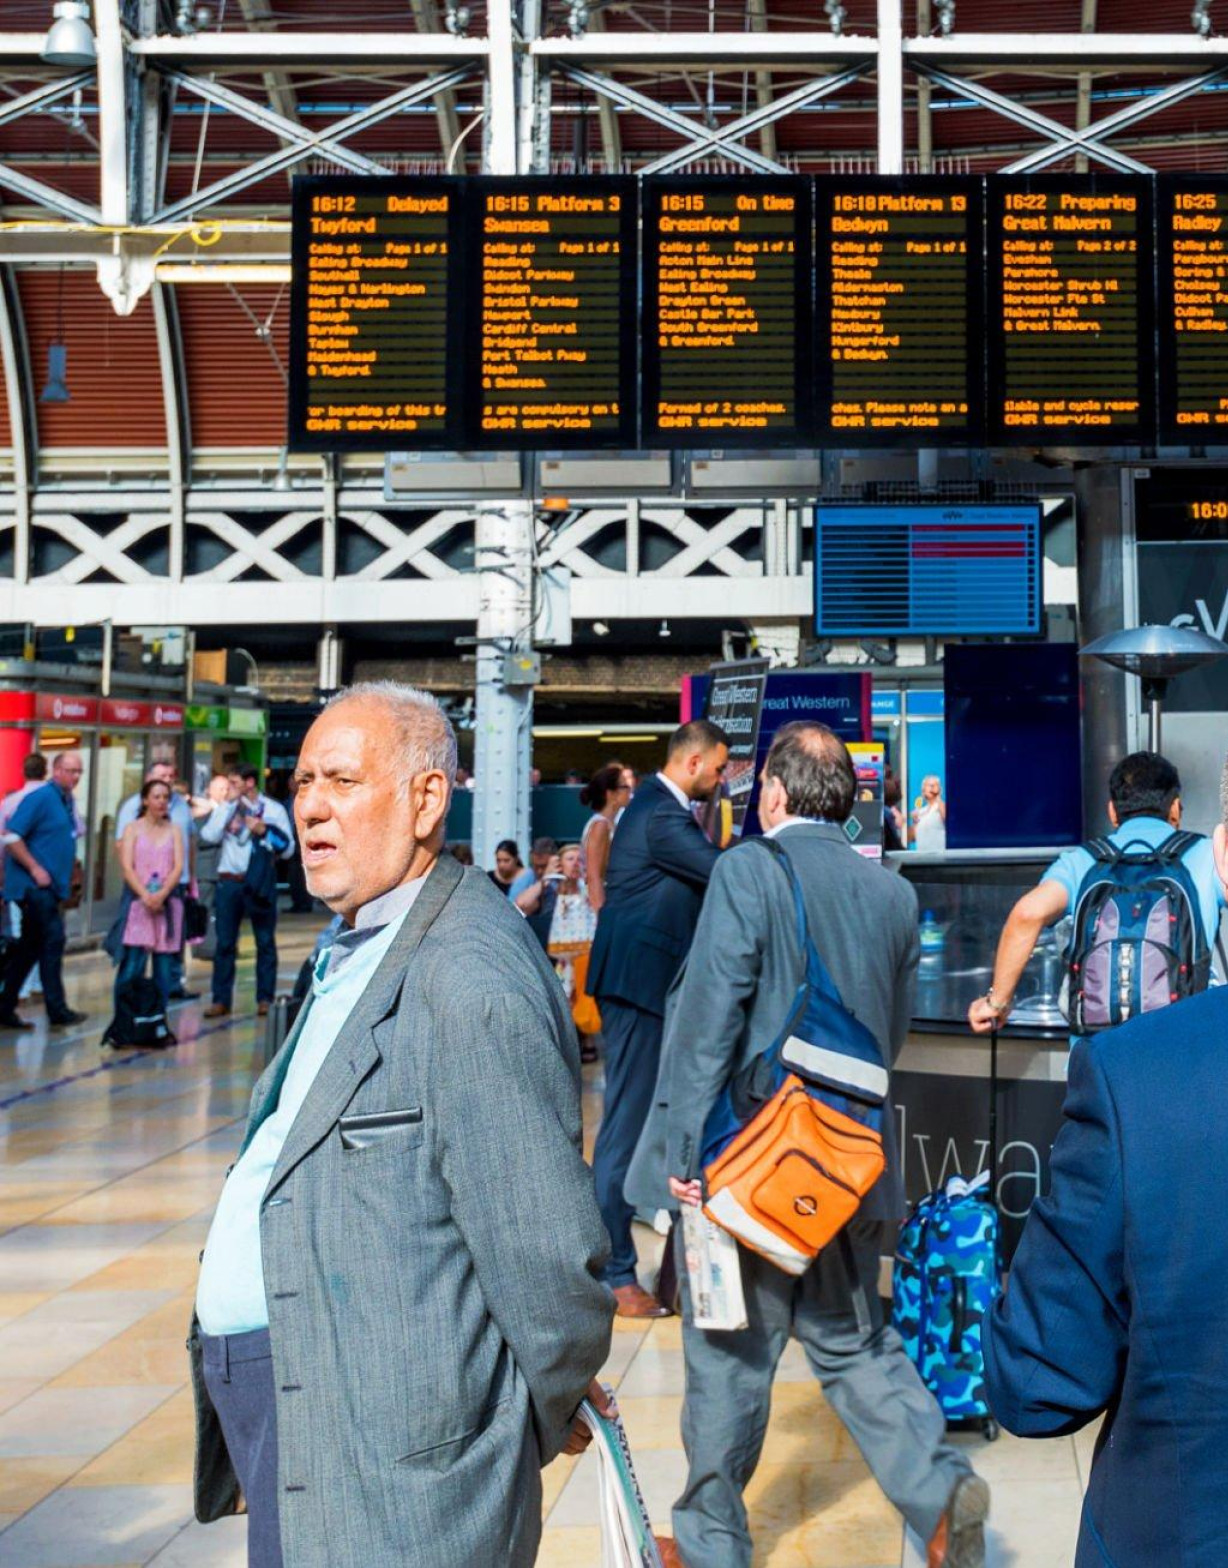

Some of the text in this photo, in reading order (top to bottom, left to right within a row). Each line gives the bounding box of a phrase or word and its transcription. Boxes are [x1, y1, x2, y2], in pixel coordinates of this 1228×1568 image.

[312, 195, 449, 214] 16:12 Delayed
[486, 195, 621, 212] 16:15 Platform 3
[661, 194, 795, 211] 16:15 On time
[877, 195, 944, 212] Platform
[1005, 193, 1137, 212] 16:22 Preparing
[1175, 193, 1217, 210] 16:25
[310, 217, 377, 236] Twyford
[483, 216, 550, 233] Swansea
[658, 215, 740, 232] Greenford
[831, 216, 889, 235] Bedwyn
[1002, 214, 1112, 231] Great Malvern
[1172, 214, 1222, 232] Radley
[761, 695, 851, 710] reat Western
